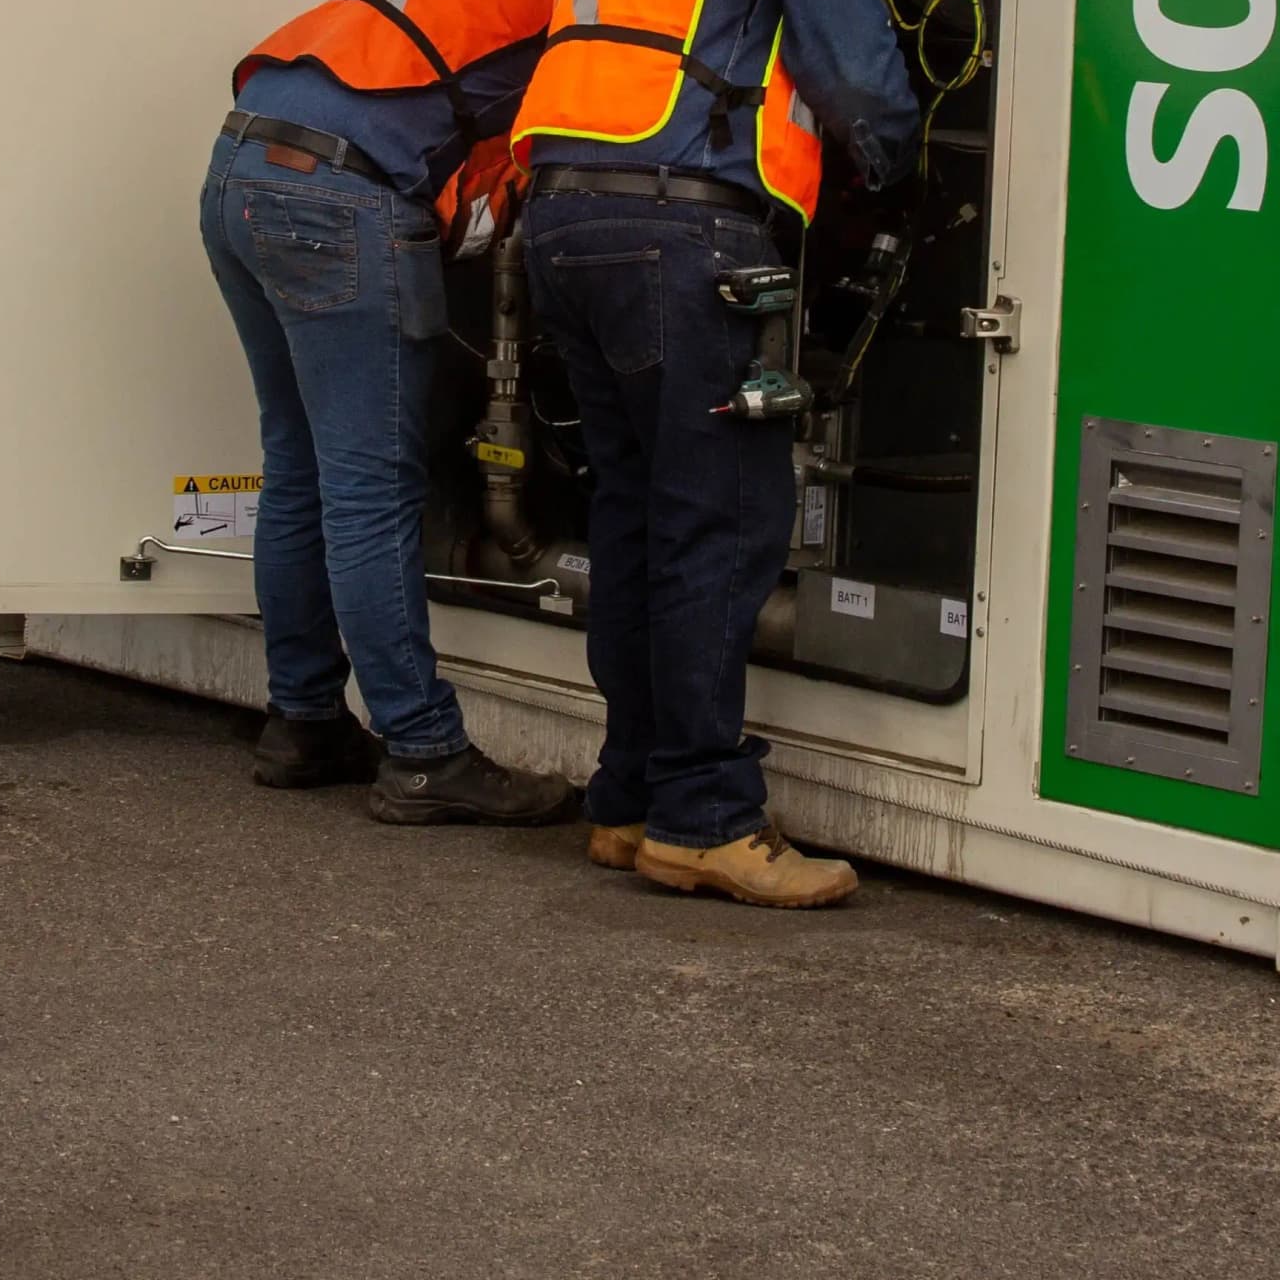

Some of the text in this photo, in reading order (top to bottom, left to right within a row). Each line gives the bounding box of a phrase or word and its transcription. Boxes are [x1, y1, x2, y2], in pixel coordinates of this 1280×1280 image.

[209, 476, 265, 490] CAUTIO
[837, 590, 868, 608] BATT 1
[947, 611, 967, 626] BAT
